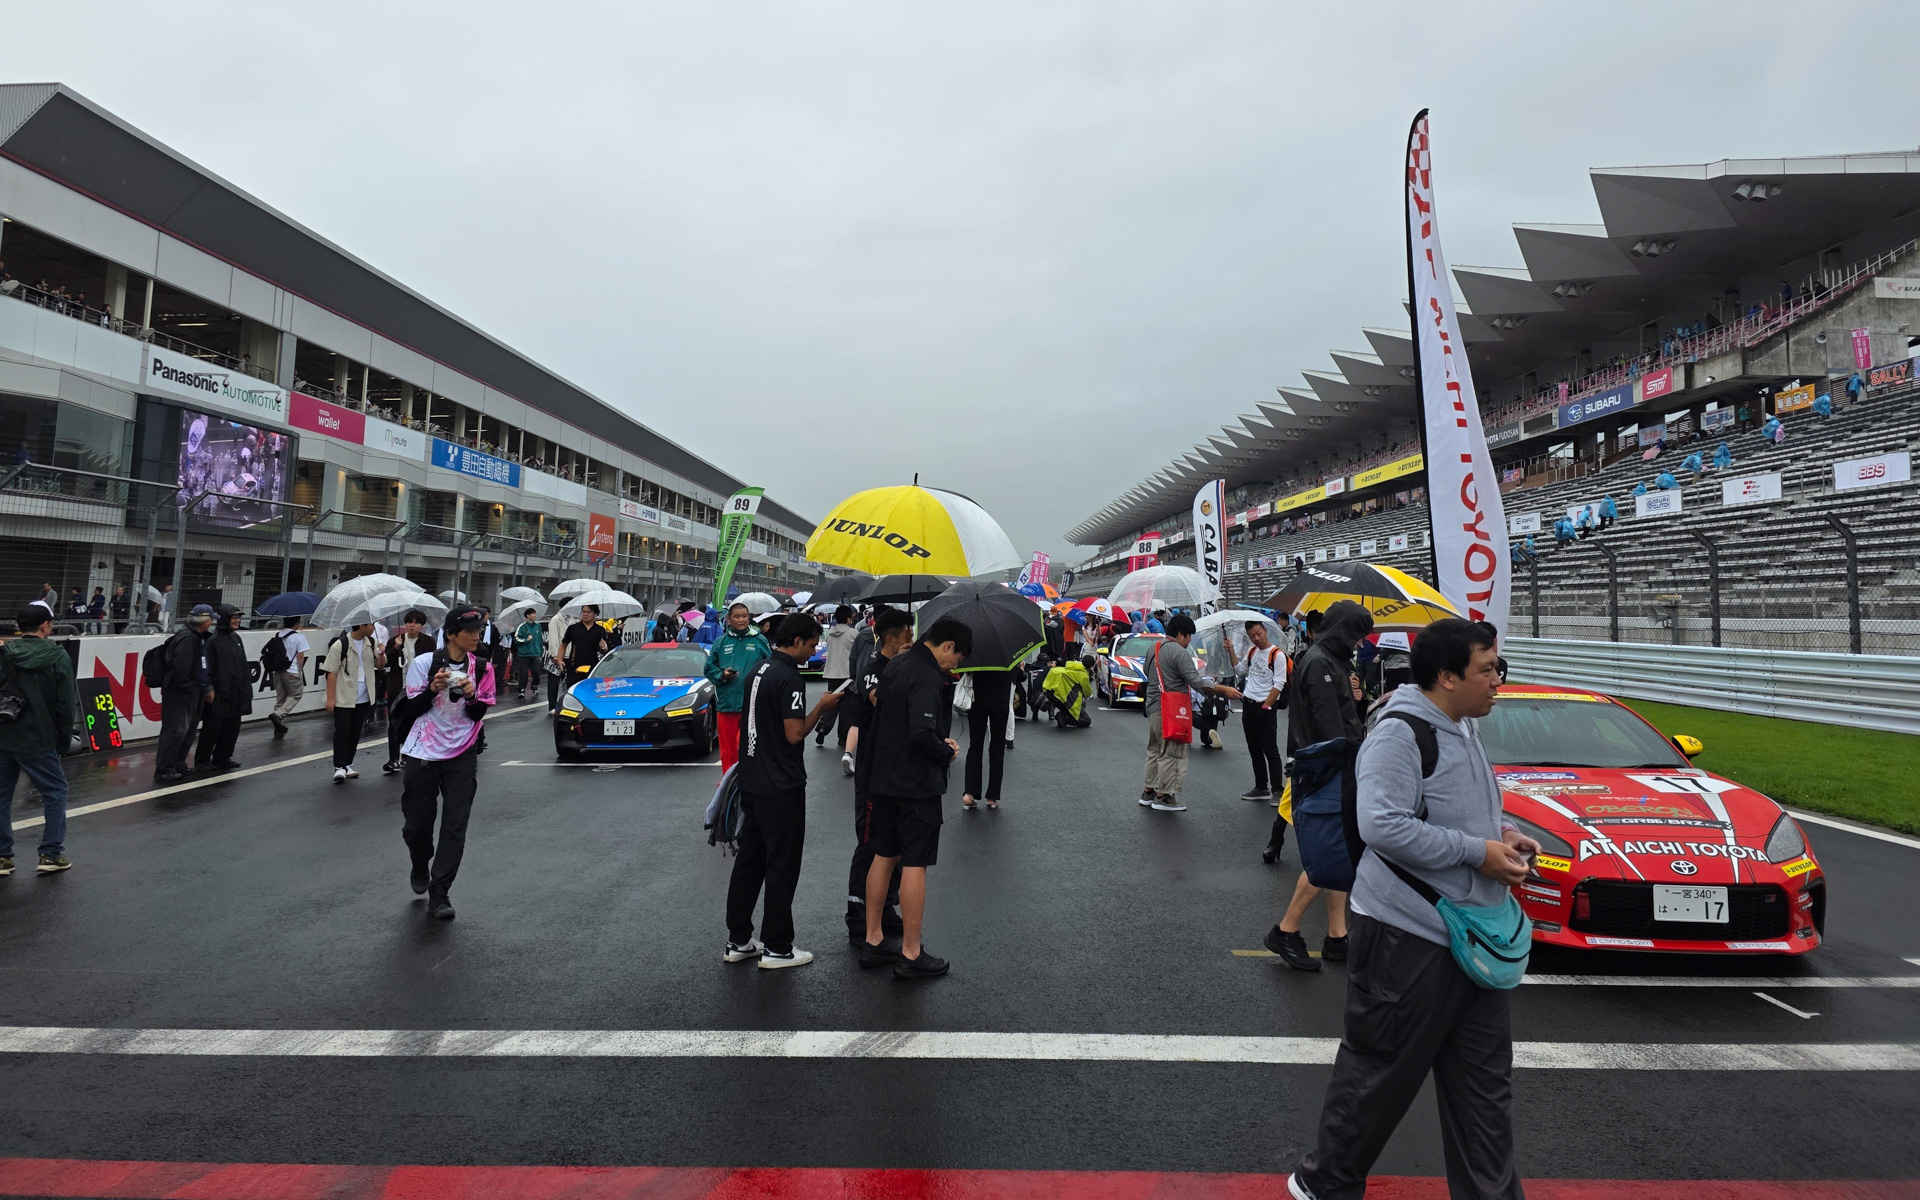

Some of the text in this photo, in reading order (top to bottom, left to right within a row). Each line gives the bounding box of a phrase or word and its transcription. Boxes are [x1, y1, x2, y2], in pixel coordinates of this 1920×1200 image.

[1870, 364, 1908, 387] SALLY
[152, 357, 282, 413] Panasonic AUTOMOTIVE
[1585, 394, 1621, 414] SUBARU
[318, 415, 340, 431] wallet
[461, 450, 510, 484] 豊田自動織機
[1401, 459, 1422, 472] DUNLOP
[1858, 463, 1886, 480] BBS
[1364, 472, 1382, 483] DUNLOP
[734, 498, 751, 511] 89
[724, 516, 741, 547] TOCHIGI
[1138, 542, 1152, 553] 88
[864, 674, 879, 690] 24
[95, 693, 114, 711] 123
[86, 712, 117, 730] P 2
[90, 729, 123, 751] L 10
[1651, 776, 1712, 793] 17
[1585, 804, 1697, 817] OBERON
[1624, 840, 1686, 855] AICHI
[1686, 842, 1772, 864] TOYOTA
[1791, 860, 1813, 873] DUNLOP
[1705, 901, 1724, 920] 17
